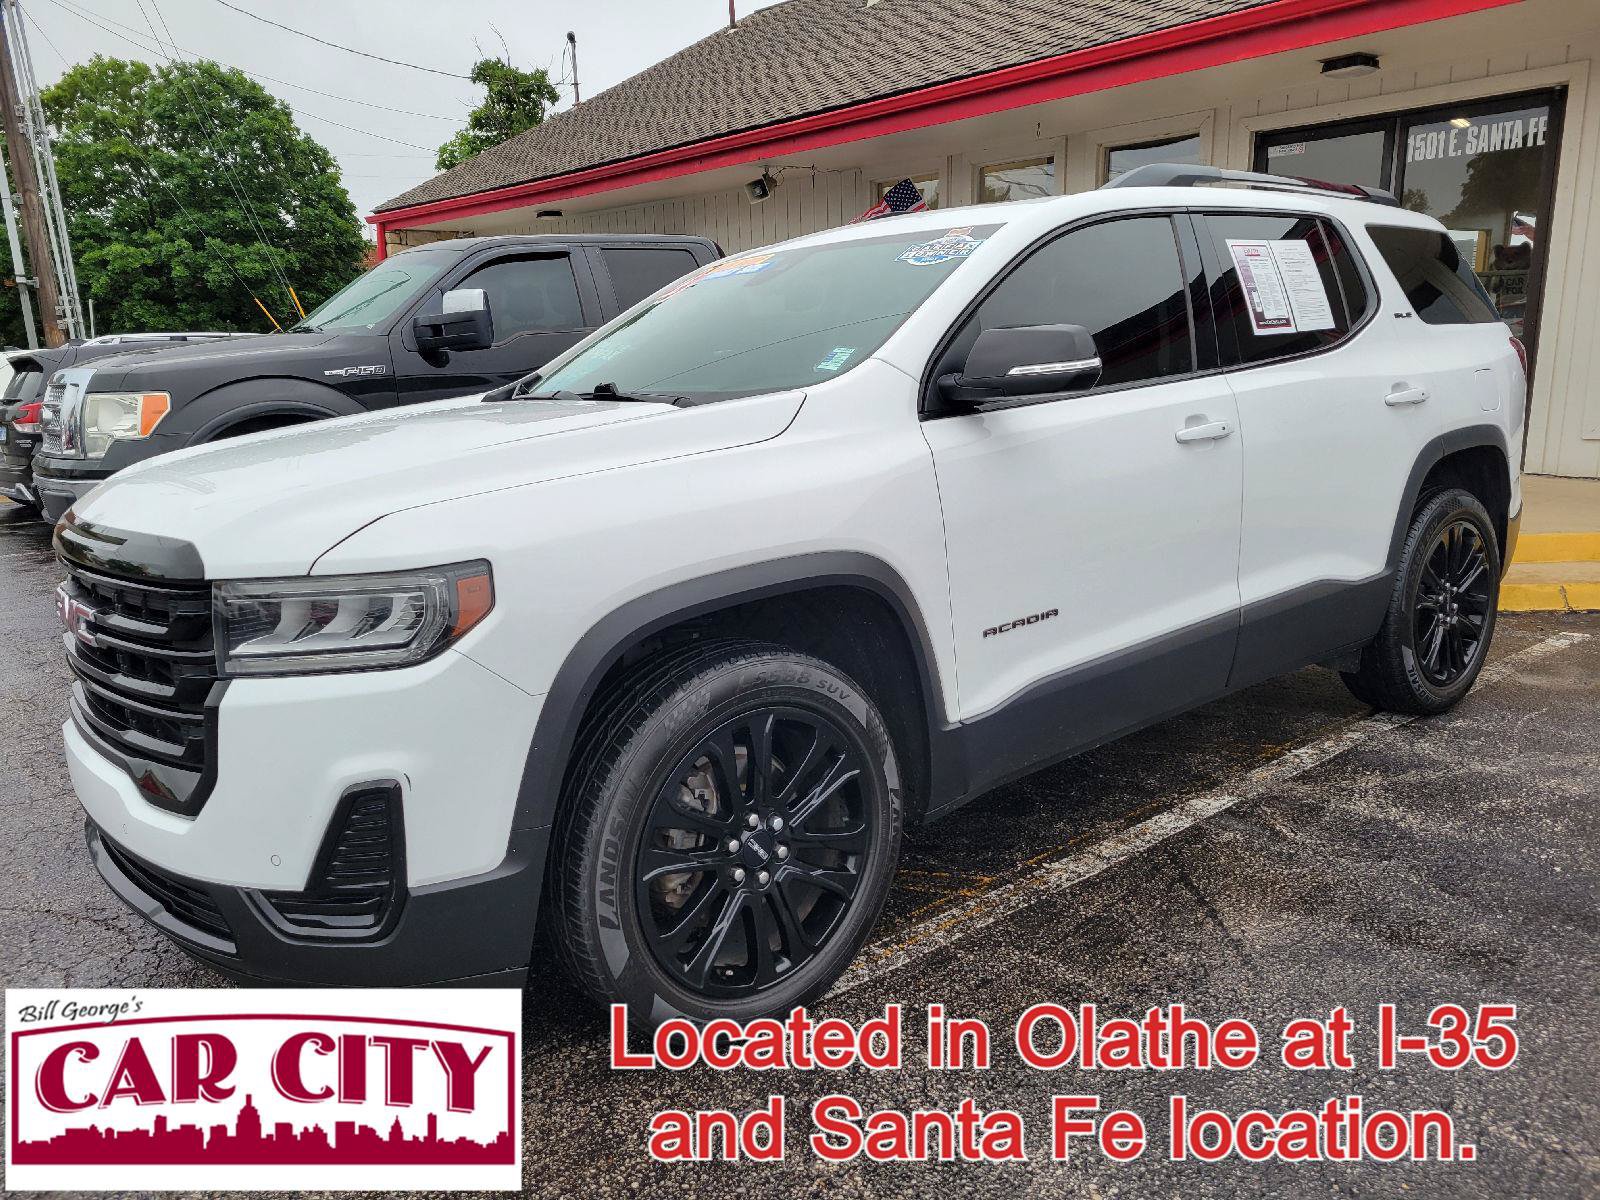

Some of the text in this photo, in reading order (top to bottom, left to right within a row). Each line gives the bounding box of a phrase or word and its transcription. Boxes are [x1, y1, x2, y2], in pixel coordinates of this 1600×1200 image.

[1408, 116, 1548, 163] 1501 E. SANTA FE
[983, 608, 1059, 638] ACADIA
[815, 679, 851, 700] SUV
